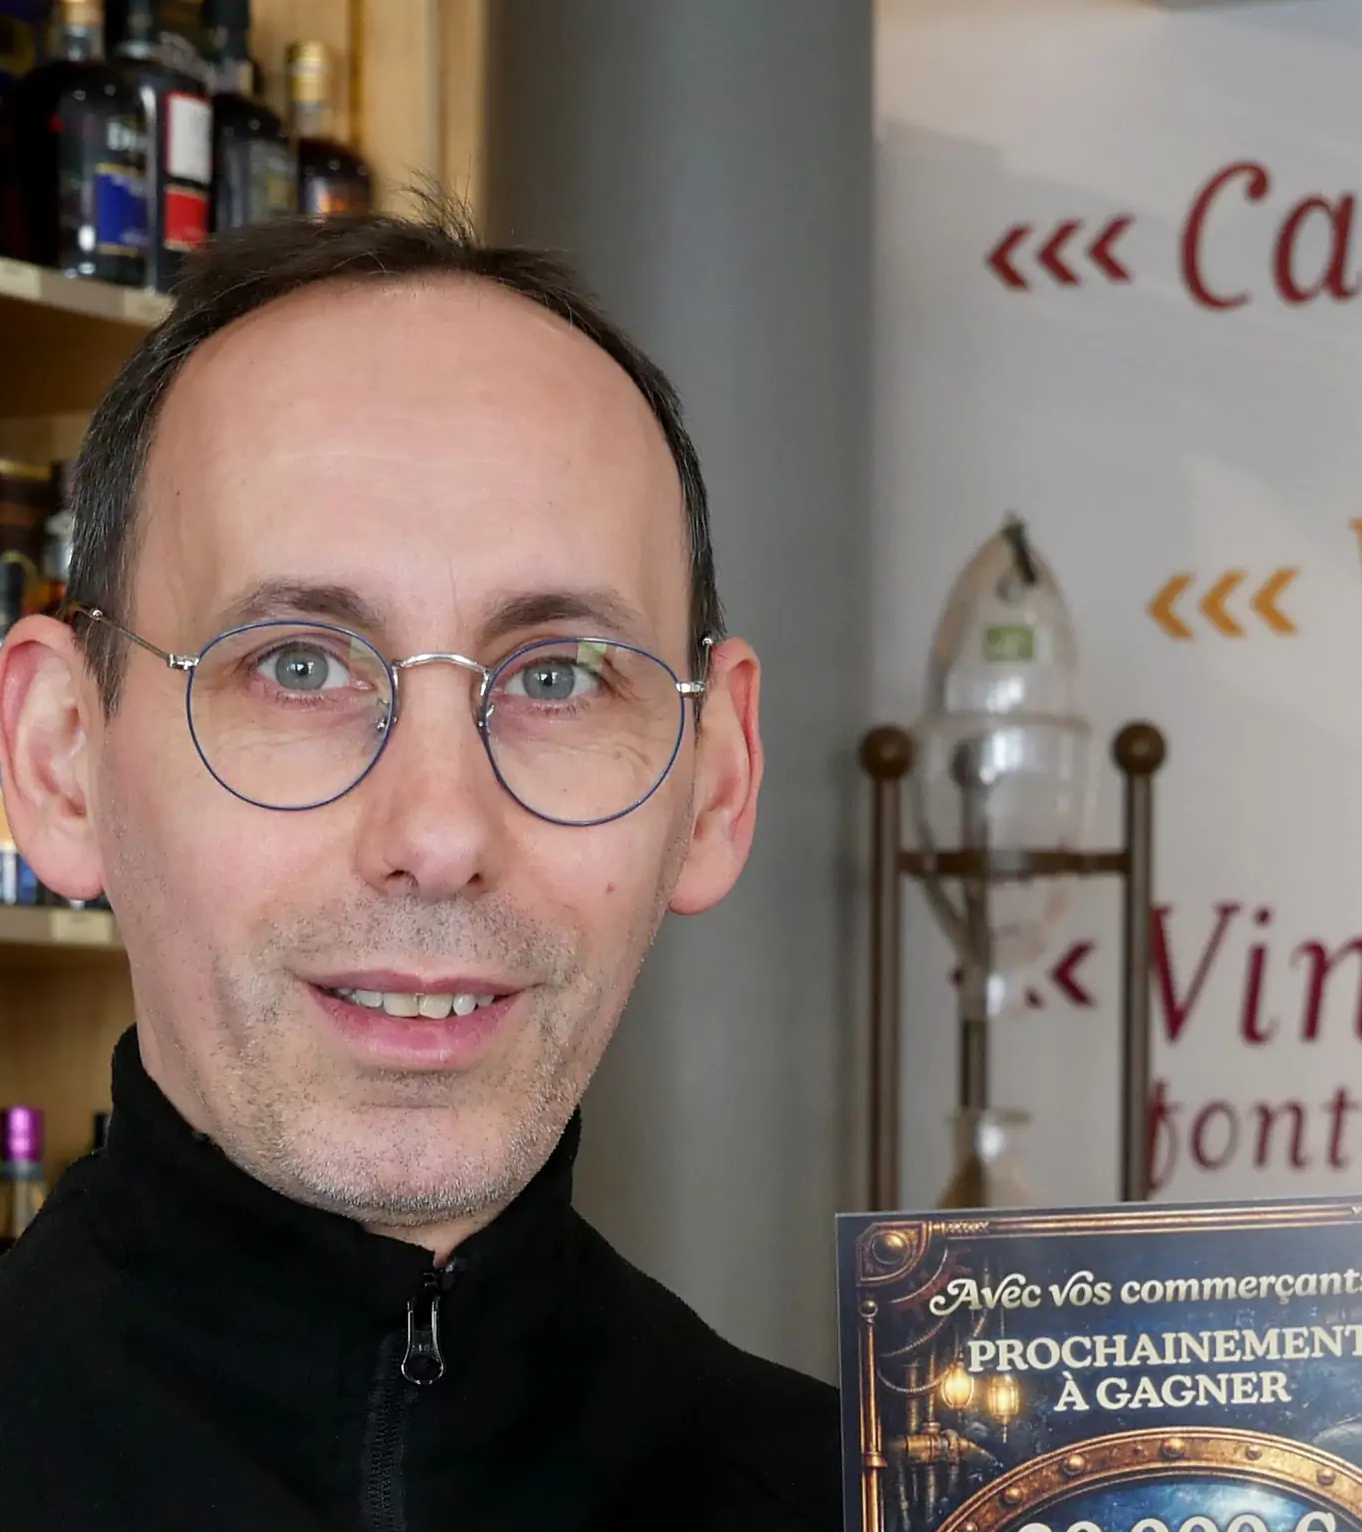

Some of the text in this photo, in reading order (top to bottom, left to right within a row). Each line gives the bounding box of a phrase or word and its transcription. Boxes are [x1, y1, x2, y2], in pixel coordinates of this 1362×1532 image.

[929, 1273, 1041, 1316] Avec
[1049, 1270, 1112, 1307] vos
[1054, 1371, 1291, 1412] À GAGNER
